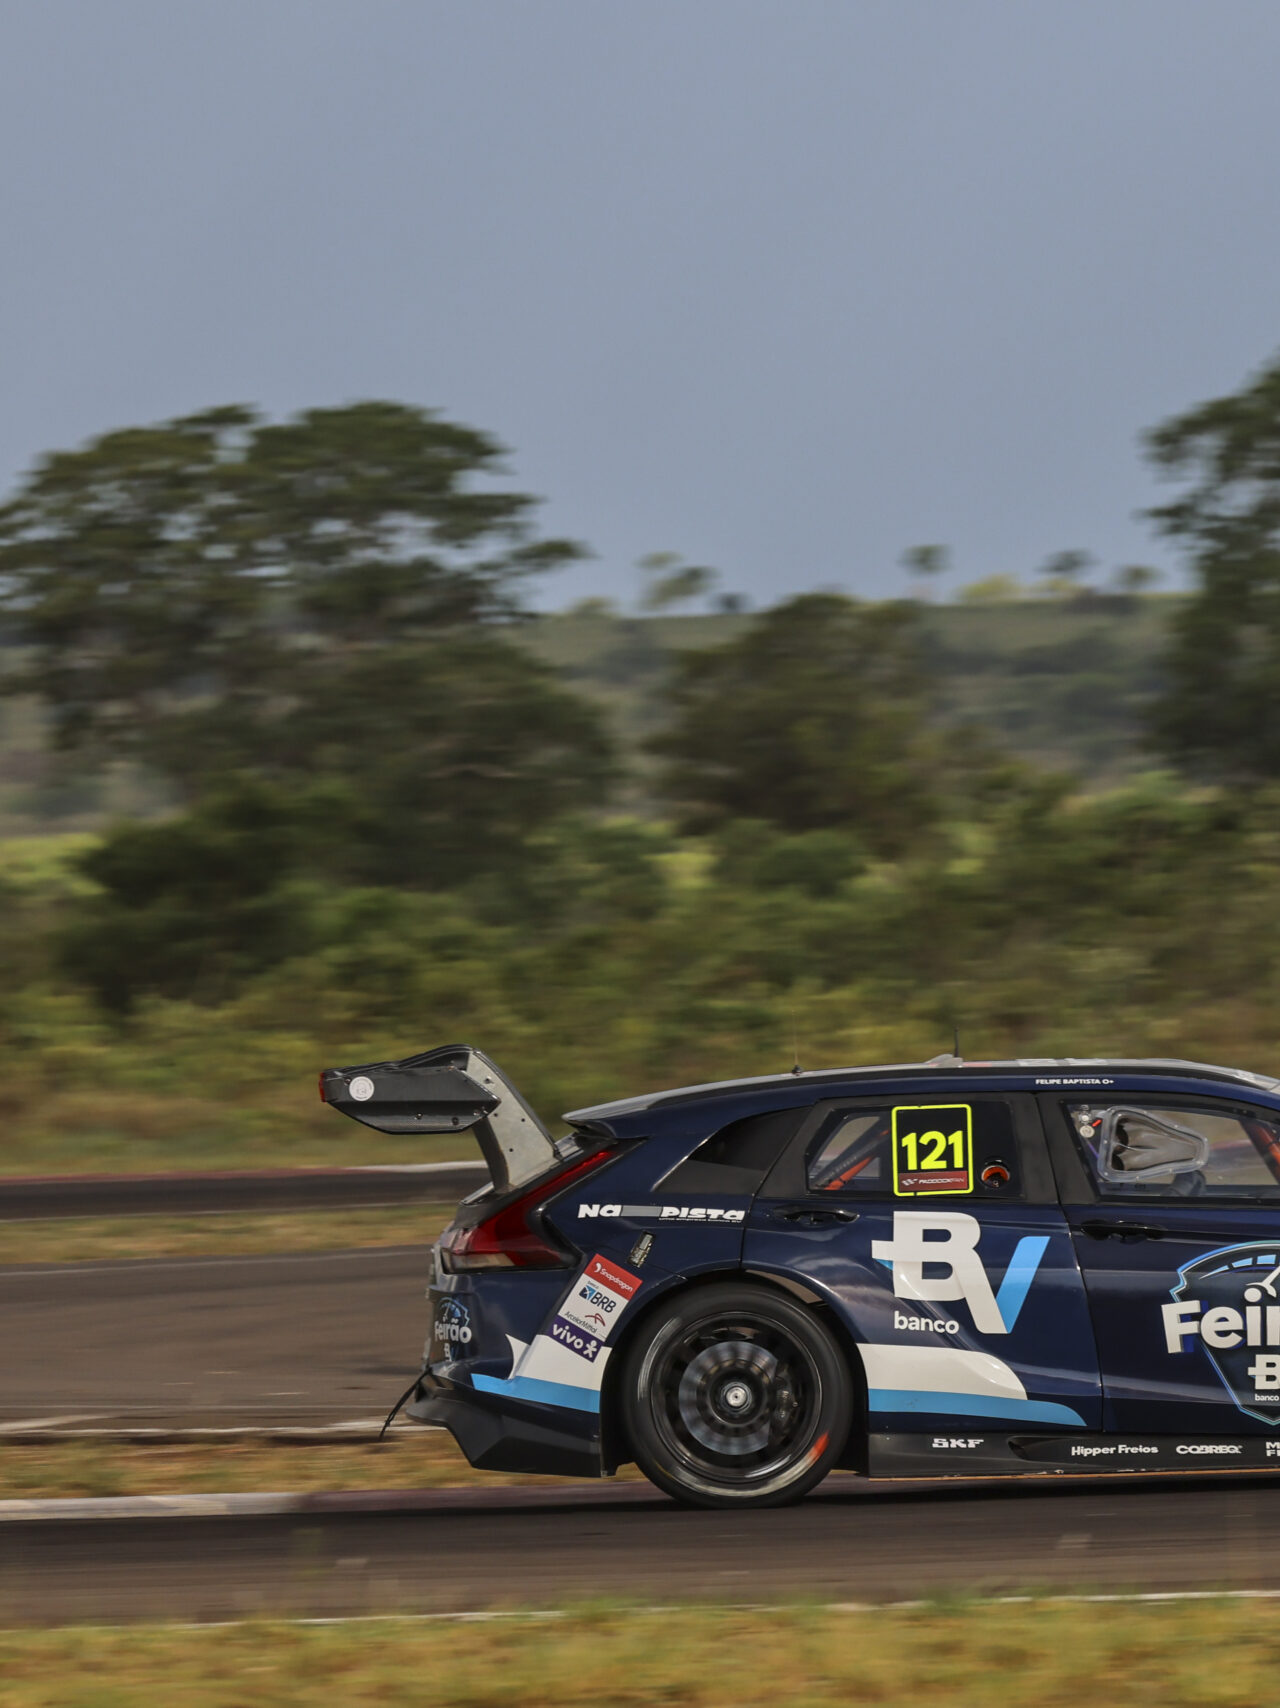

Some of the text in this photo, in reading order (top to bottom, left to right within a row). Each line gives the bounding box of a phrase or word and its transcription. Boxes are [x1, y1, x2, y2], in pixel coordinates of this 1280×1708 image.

[901, 1130, 964, 1170] 121
[599, 1267, 634, 1293] Snapdragon
[871, 1210, 1051, 1335] BV
[590, 1291, 617, 1313] BRB
[894, 1310, 960, 1335] banco
[552, 1323, 584, 1349] vivo
[1254, 1393, 1280, 1402] banco
[932, 1438, 984, 1449] SKF
[1071, 1445, 1159, 1457] Hipper Freios
